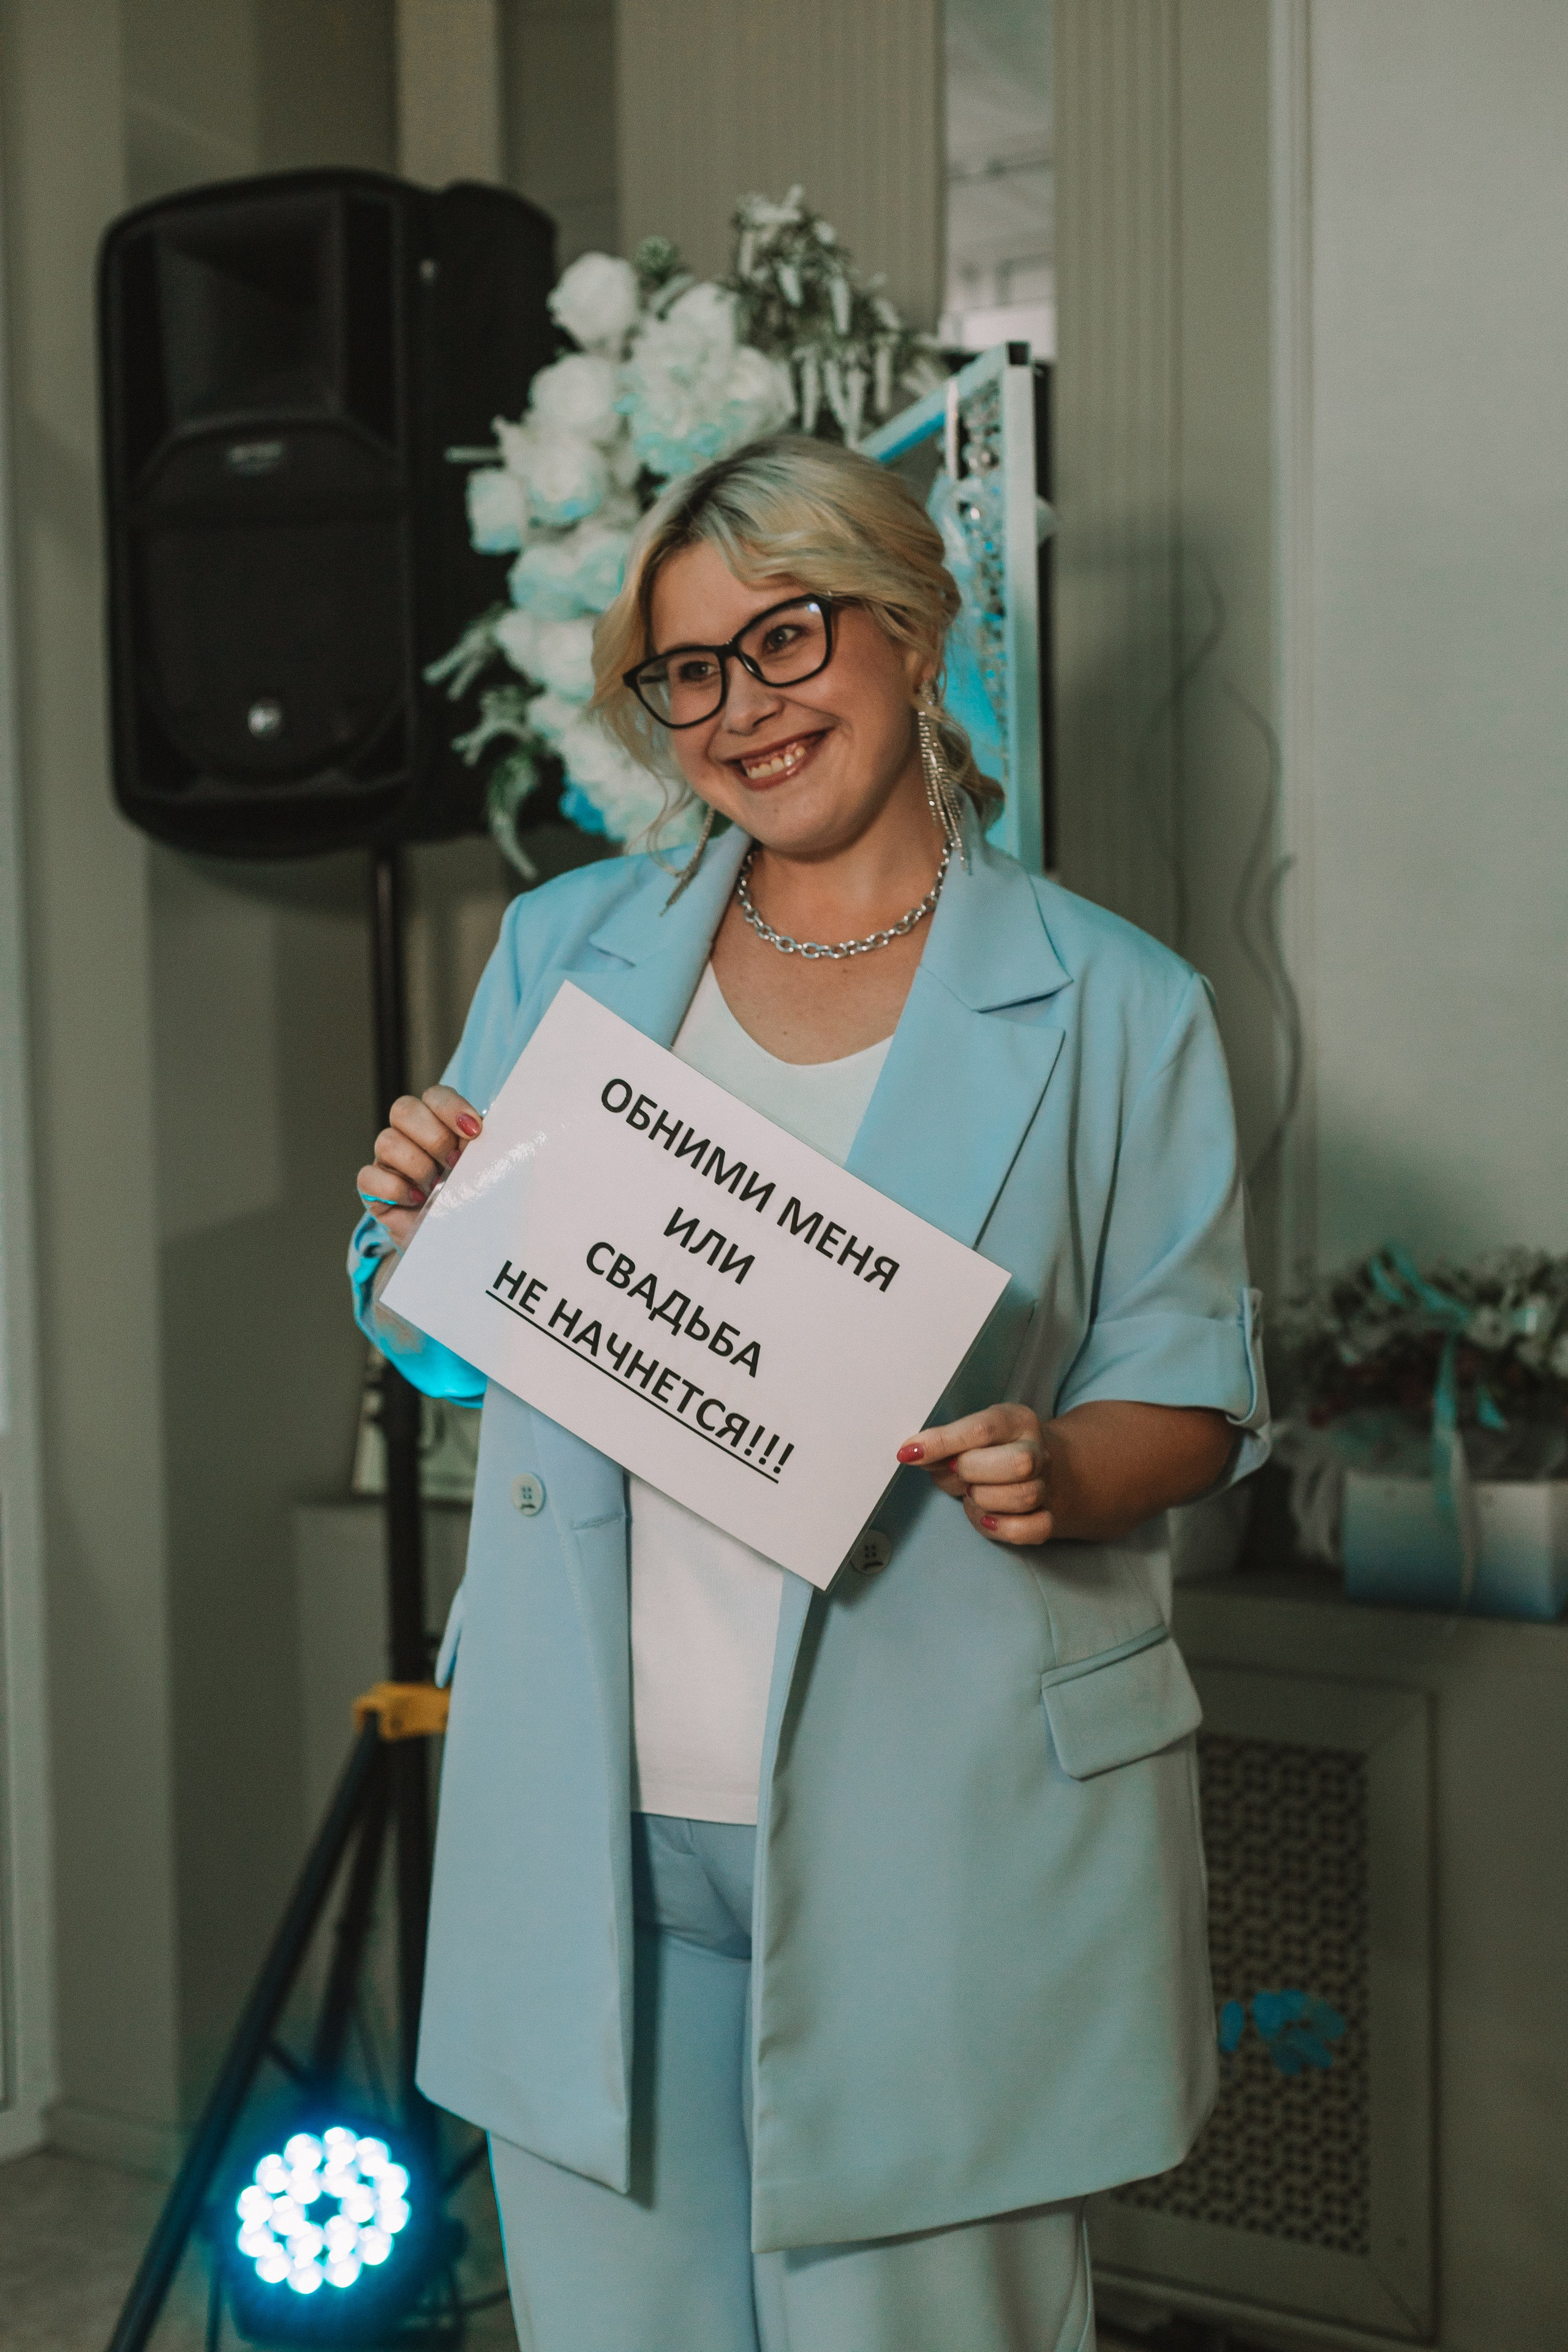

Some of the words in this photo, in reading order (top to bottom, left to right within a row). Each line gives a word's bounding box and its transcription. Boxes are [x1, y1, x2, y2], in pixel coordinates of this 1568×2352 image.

[601, 1079, 777, 1213] ОБНИМИ
[777, 1196, 900, 1292] МЕНЯ
[663, 1207, 756, 1285] ИЛИ
[492, 1260, 549, 1315] НЕ
[548, 1298, 795, 1474] НАЧНЕТСЯ!!!
[586, 1241, 761, 1378] СВАДЬБА
